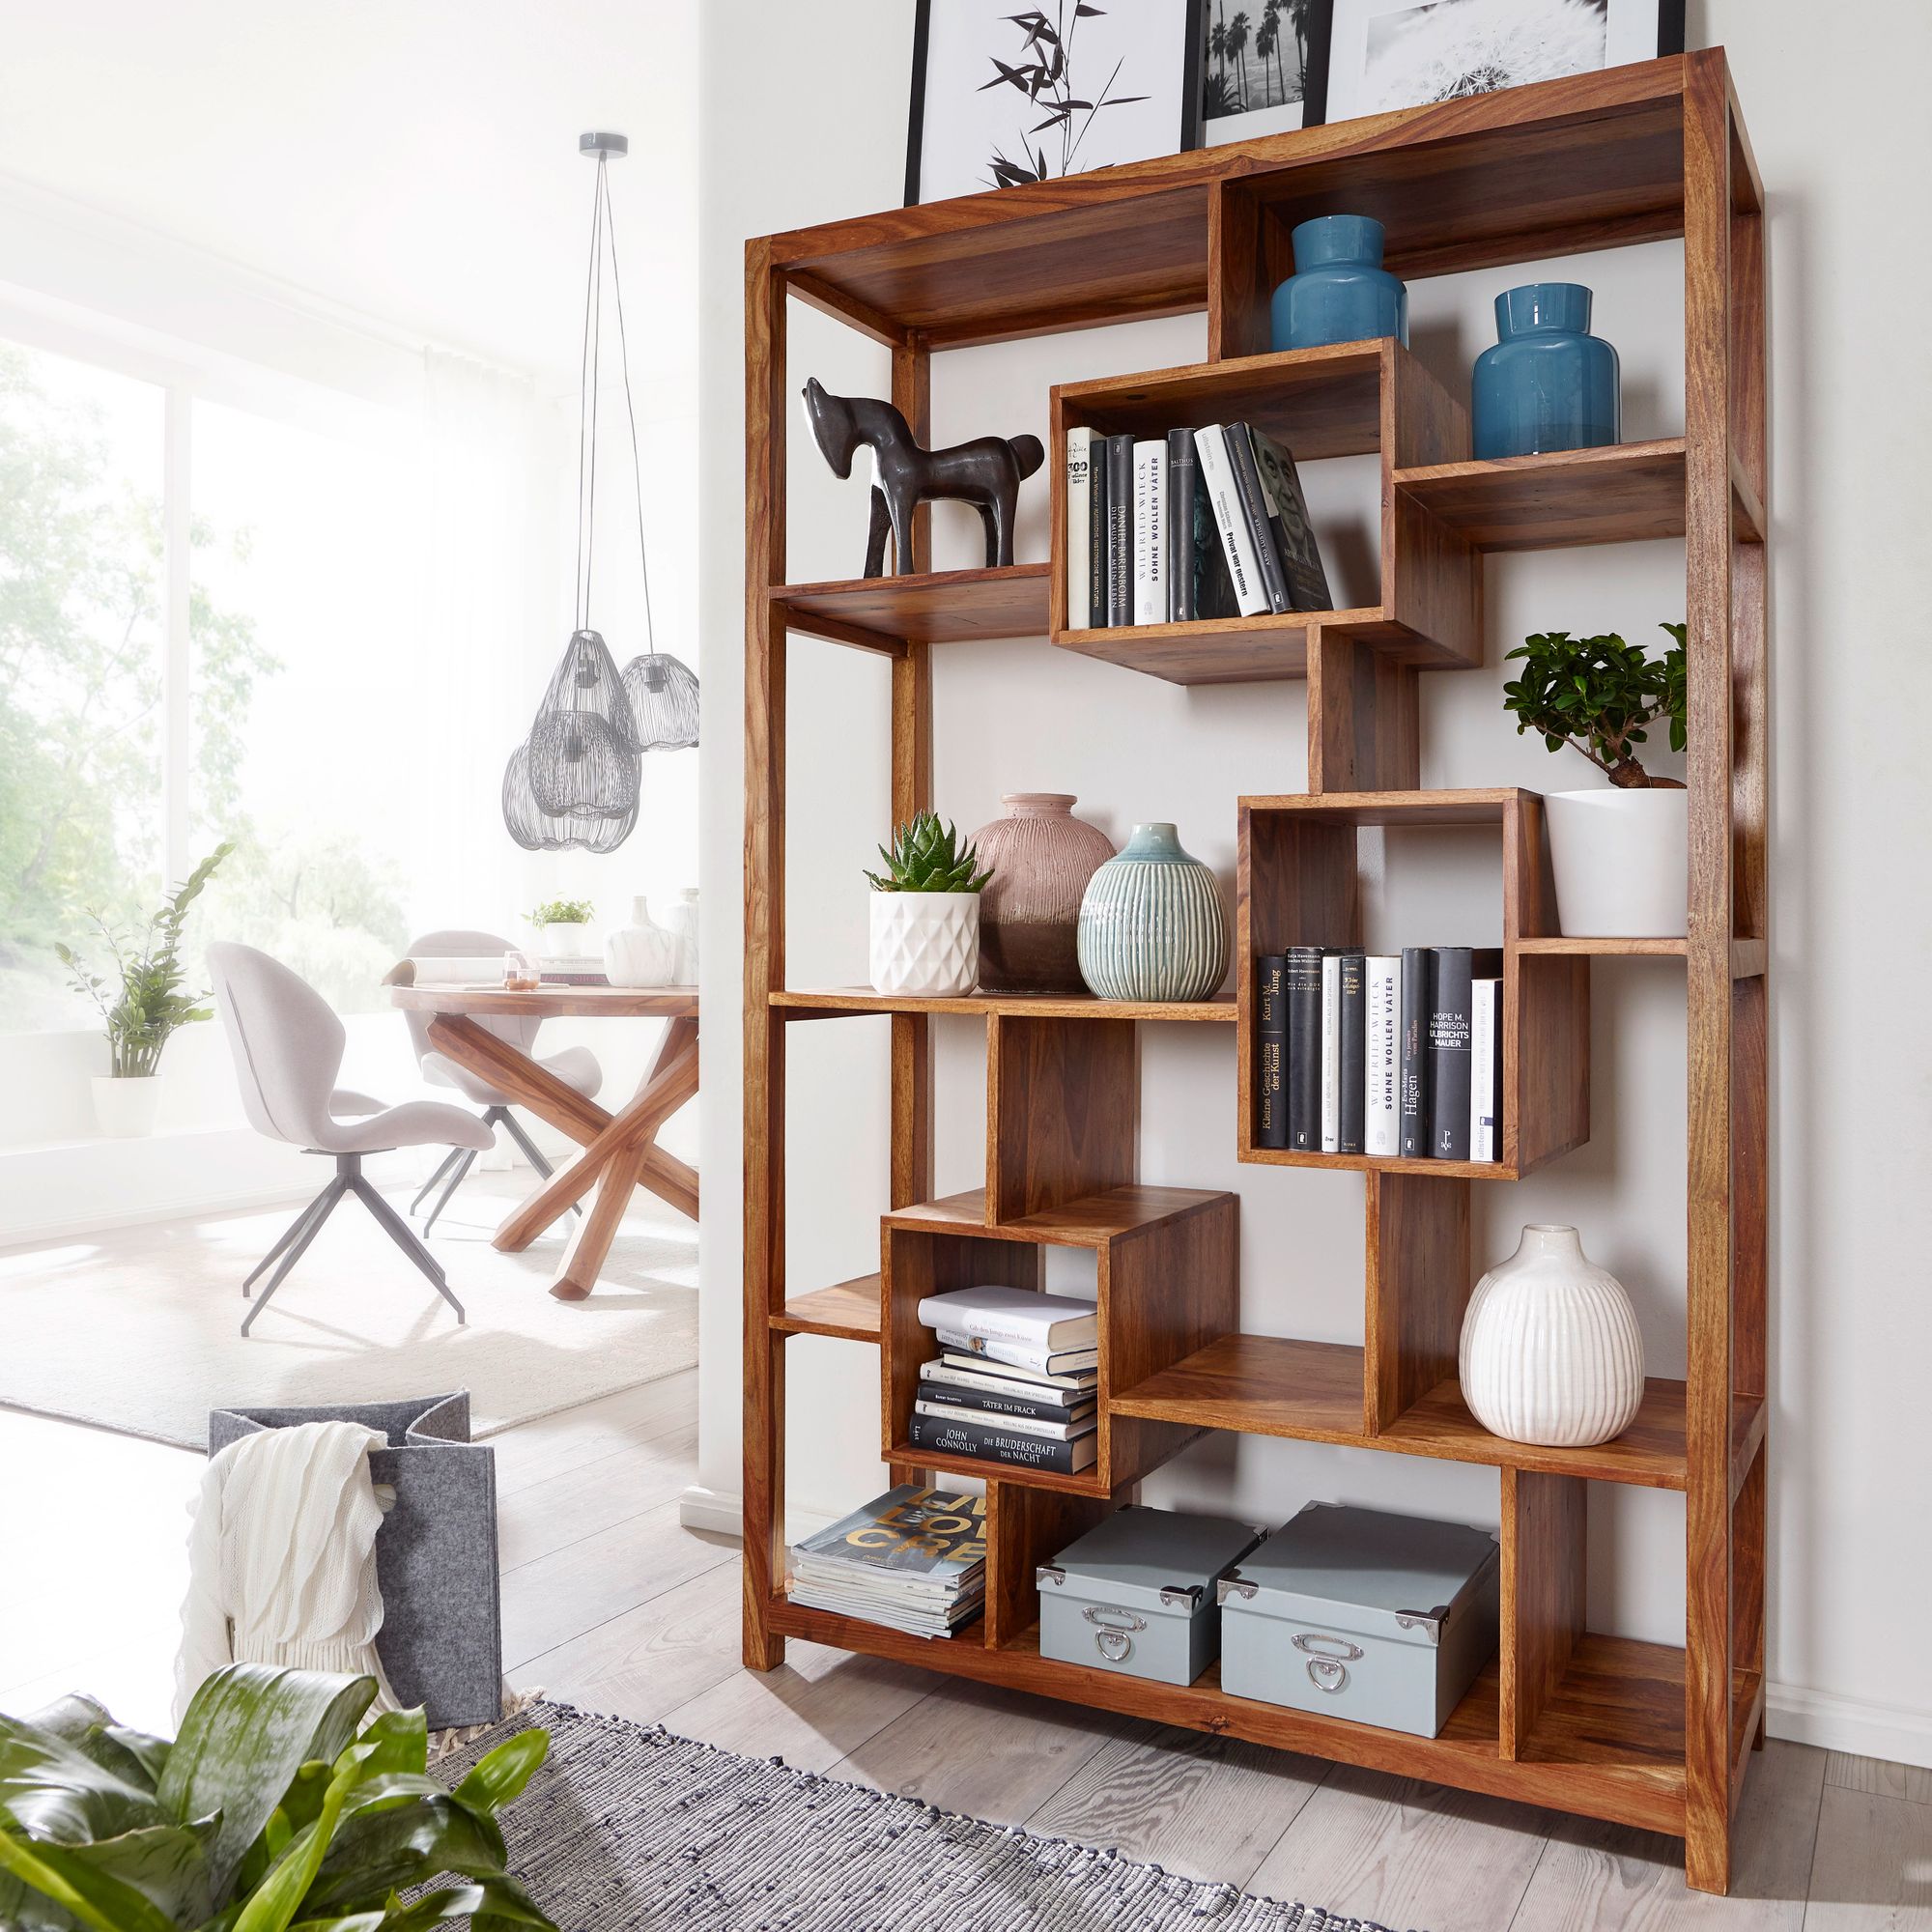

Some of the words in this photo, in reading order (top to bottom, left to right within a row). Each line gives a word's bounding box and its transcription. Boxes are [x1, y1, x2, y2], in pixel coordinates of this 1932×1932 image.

[1138, 463, 1147, 508] WIECK
[1150, 457, 1158, 492] VÄTER
[1118, 505, 1126, 545] DANIEL
[1138, 512, 1147, 581] WILFRIED
[1226, 531, 1237, 554] Privat
[1232, 553, 1241, 568] war
[1118, 546, 1126, 608] BARENBOIM
[1236, 567, 1249, 597] gestern
[1262, 982, 1271, 994] M.
[1270, 969, 1281, 995] Jung
[1383, 977, 1393, 1013] VÄTER
[1262, 996, 1271, 1021] Kurt
[1371, 981, 1379, 1028] WIECK
[1434, 1012, 1453, 1021] HOPE
[1430, 1021, 1468, 1031] HARRISON
[1430, 1030, 1469, 1039] ULBRICHTS
[1435, 1038, 1462, 1047] MAUER
[1262, 1042, 1271, 1096] Geschichte
[1270, 1042, 1280, 1070] Kunst
[1270, 1070, 1280, 1091] der
[1371, 1034, 1379, 1106] WILFRIED
[1383, 1071, 1393, 1110] SÖHNE
[1405, 1074, 1420, 1116] Hagen
[1262, 1097, 1271, 1129] Kleine
[981, 1400, 1003, 1410] TÄTER
[1004, 1403, 1013, 1411] IM
[1013, 1405, 1037, 1416] FRACK
[935, 1436, 978, 1453] CONNOLLY
[946, 1429, 968, 1441] JOHN
[983, 1437, 994, 1446] DIE
[995, 1437, 1057, 1457] BRUDERSCHAFT
[1000, 1450, 1012, 1459] DER
[1012, 1451, 1040, 1463] NACHT
